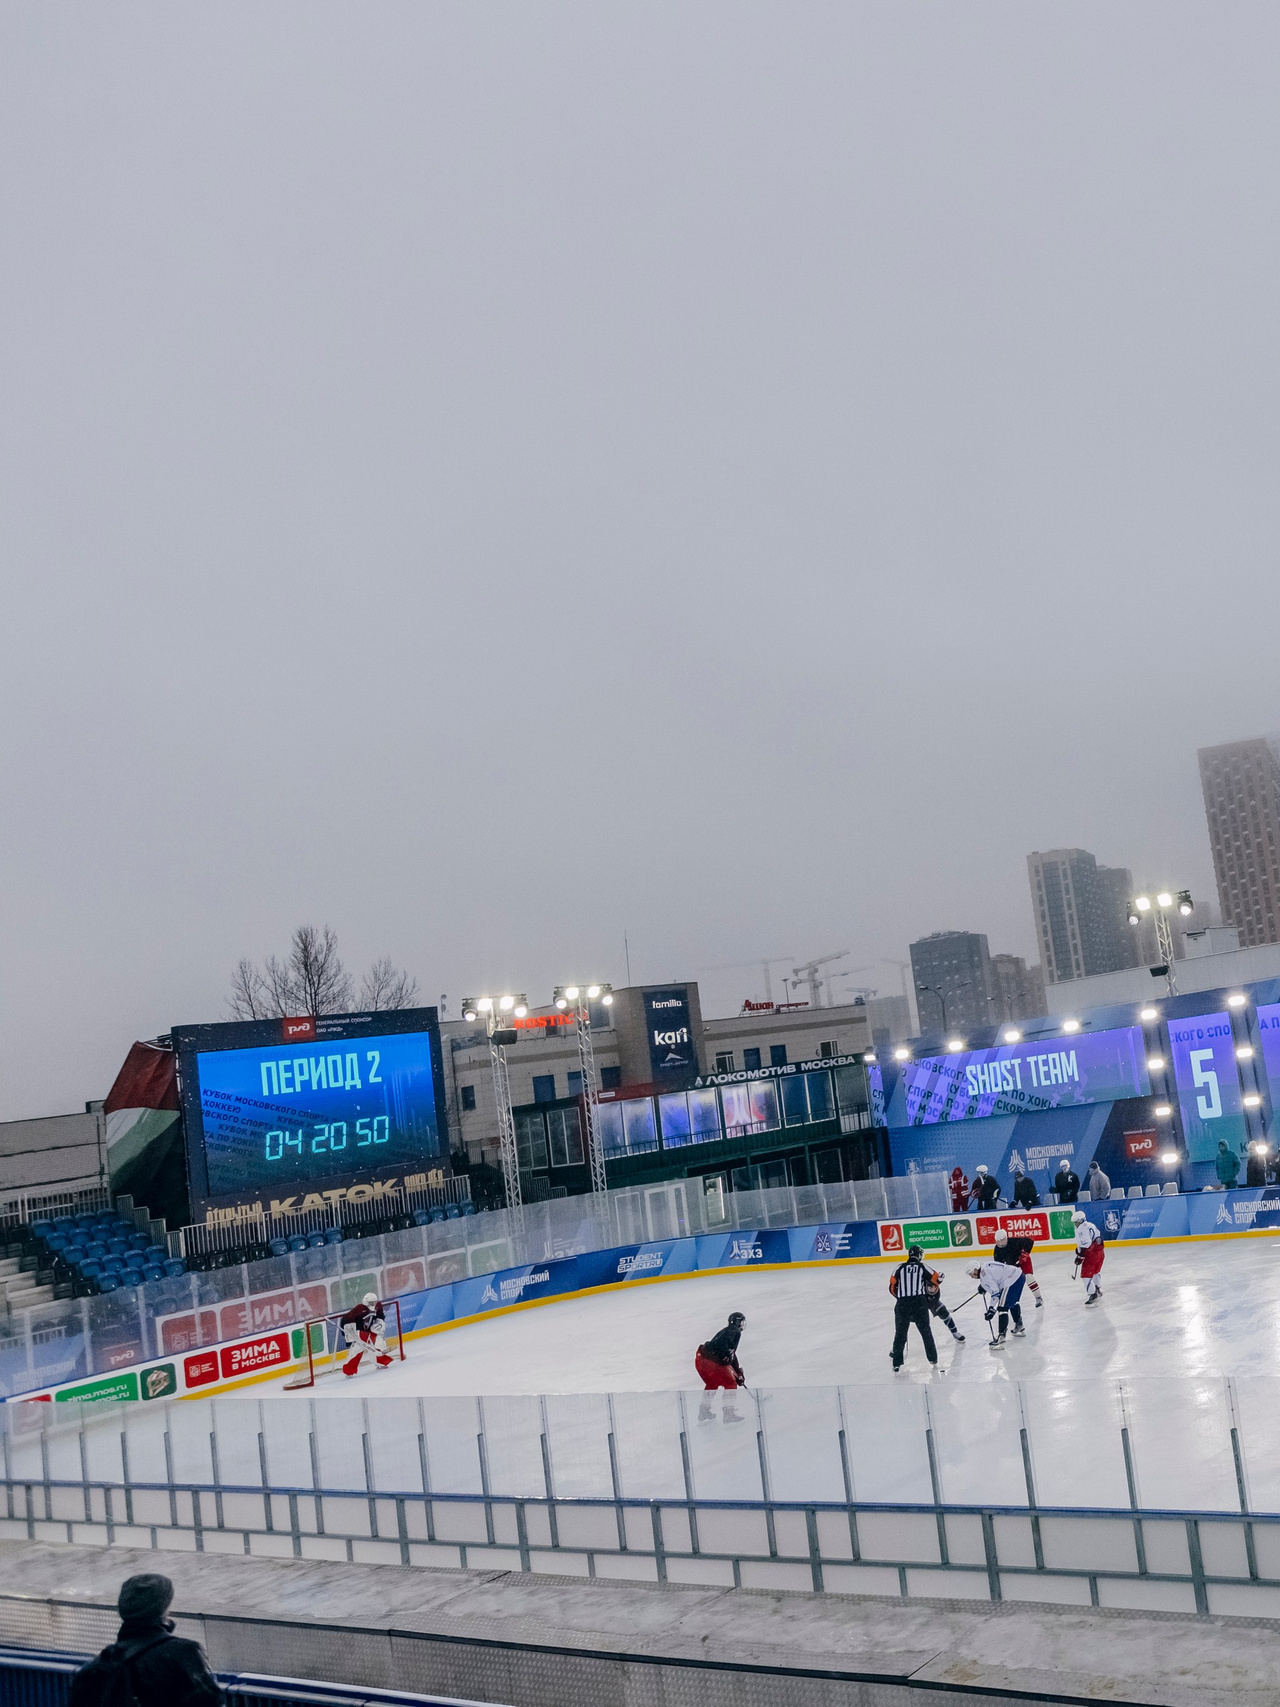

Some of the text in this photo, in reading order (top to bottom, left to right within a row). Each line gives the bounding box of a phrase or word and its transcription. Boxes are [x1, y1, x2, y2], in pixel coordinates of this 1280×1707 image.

[652, 999, 683, 1009] familia
[653, 1027, 689, 1046] kari
[260, 1050, 383, 1097] ПЕРИОД 2
[705, 1055, 856, 1086] ЛОКОМОТИВ МОСКВА
[965, 1050, 1080, 1096] SHOST TEAM
[1189, 1048, 1223, 1119] 5
[203, 1088, 233, 1102] КУБОК
[234, 1096, 298, 1116] МОСКОВСКОГО
[908, 1085, 944, 1107] СПОРТА
[1011, 1089, 1026, 1103] ПО
[203, 1099, 242, 1114] ХОККЕЮ
[240, 1117, 274, 1132] СПОРТА
[266, 1115, 389, 1161] 04 20 50
[1025, 1140, 1075, 1160] МОСКОВСКИЙ
[1027, 1157, 1051, 1172] СПОРТ
[270, 1178, 400, 1219] КАТОК
[1006, 1217, 1042, 1232] ЗИМА
[1235, 1211, 1257, 1224] СПОРТ
[909, 1228, 944, 1237] zima.mos.ru
[909, 1235, 945, 1244] sport.mos.ru
[1014, 1229, 1043, 1238] МОСКВЕ
[619, 1252, 664, 1266] STUDENT
[500, 1269, 550, 1291] МОСКОВСКИЙ
[500, 1285, 524, 1300] СПОРТ
[231, 1340, 281, 1363] ЗИМА
[232, 1358, 240, 1371] В
[240, 1351, 282, 1370] МОСКВЕ
